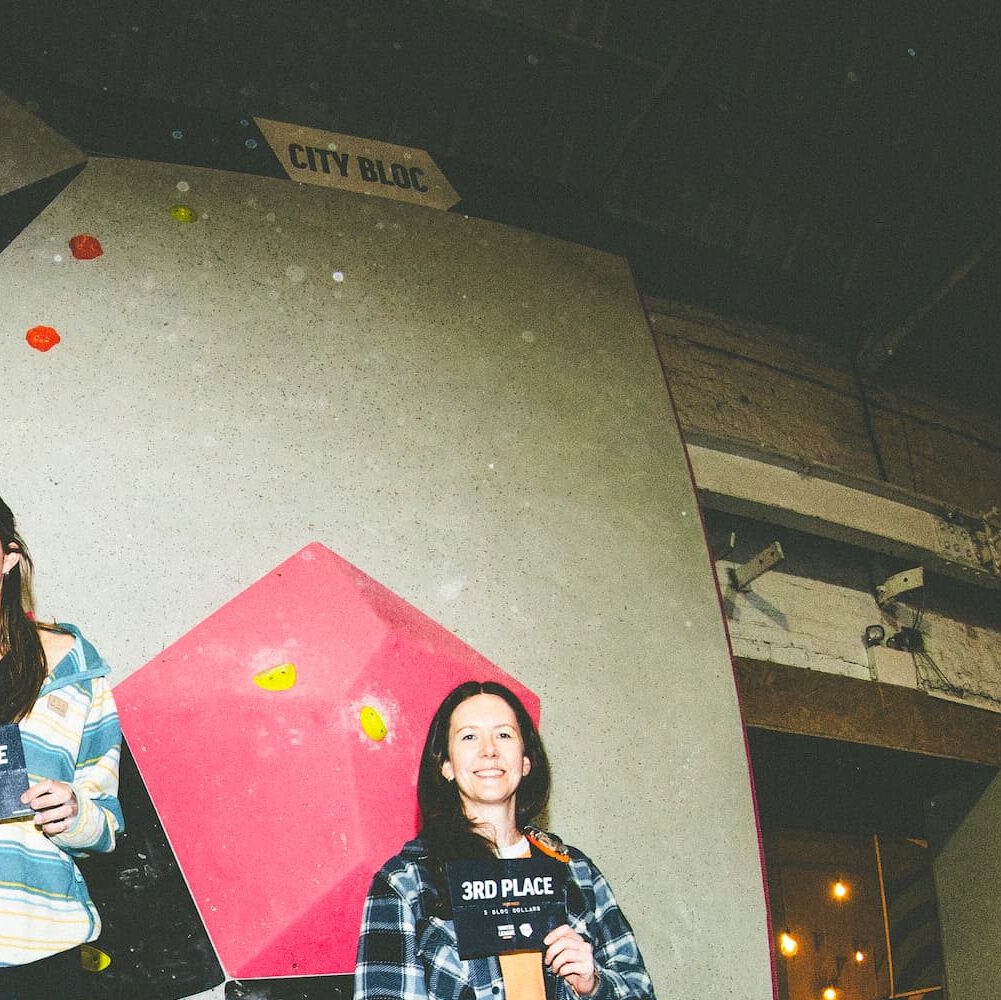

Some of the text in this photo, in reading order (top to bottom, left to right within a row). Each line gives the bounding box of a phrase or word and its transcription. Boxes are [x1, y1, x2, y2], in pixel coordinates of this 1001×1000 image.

[288, 143, 429, 193] CITY BLOC
[461, 876, 554, 901] 3RD PLACE
[512, 906, 541, 914] DOLLARS
